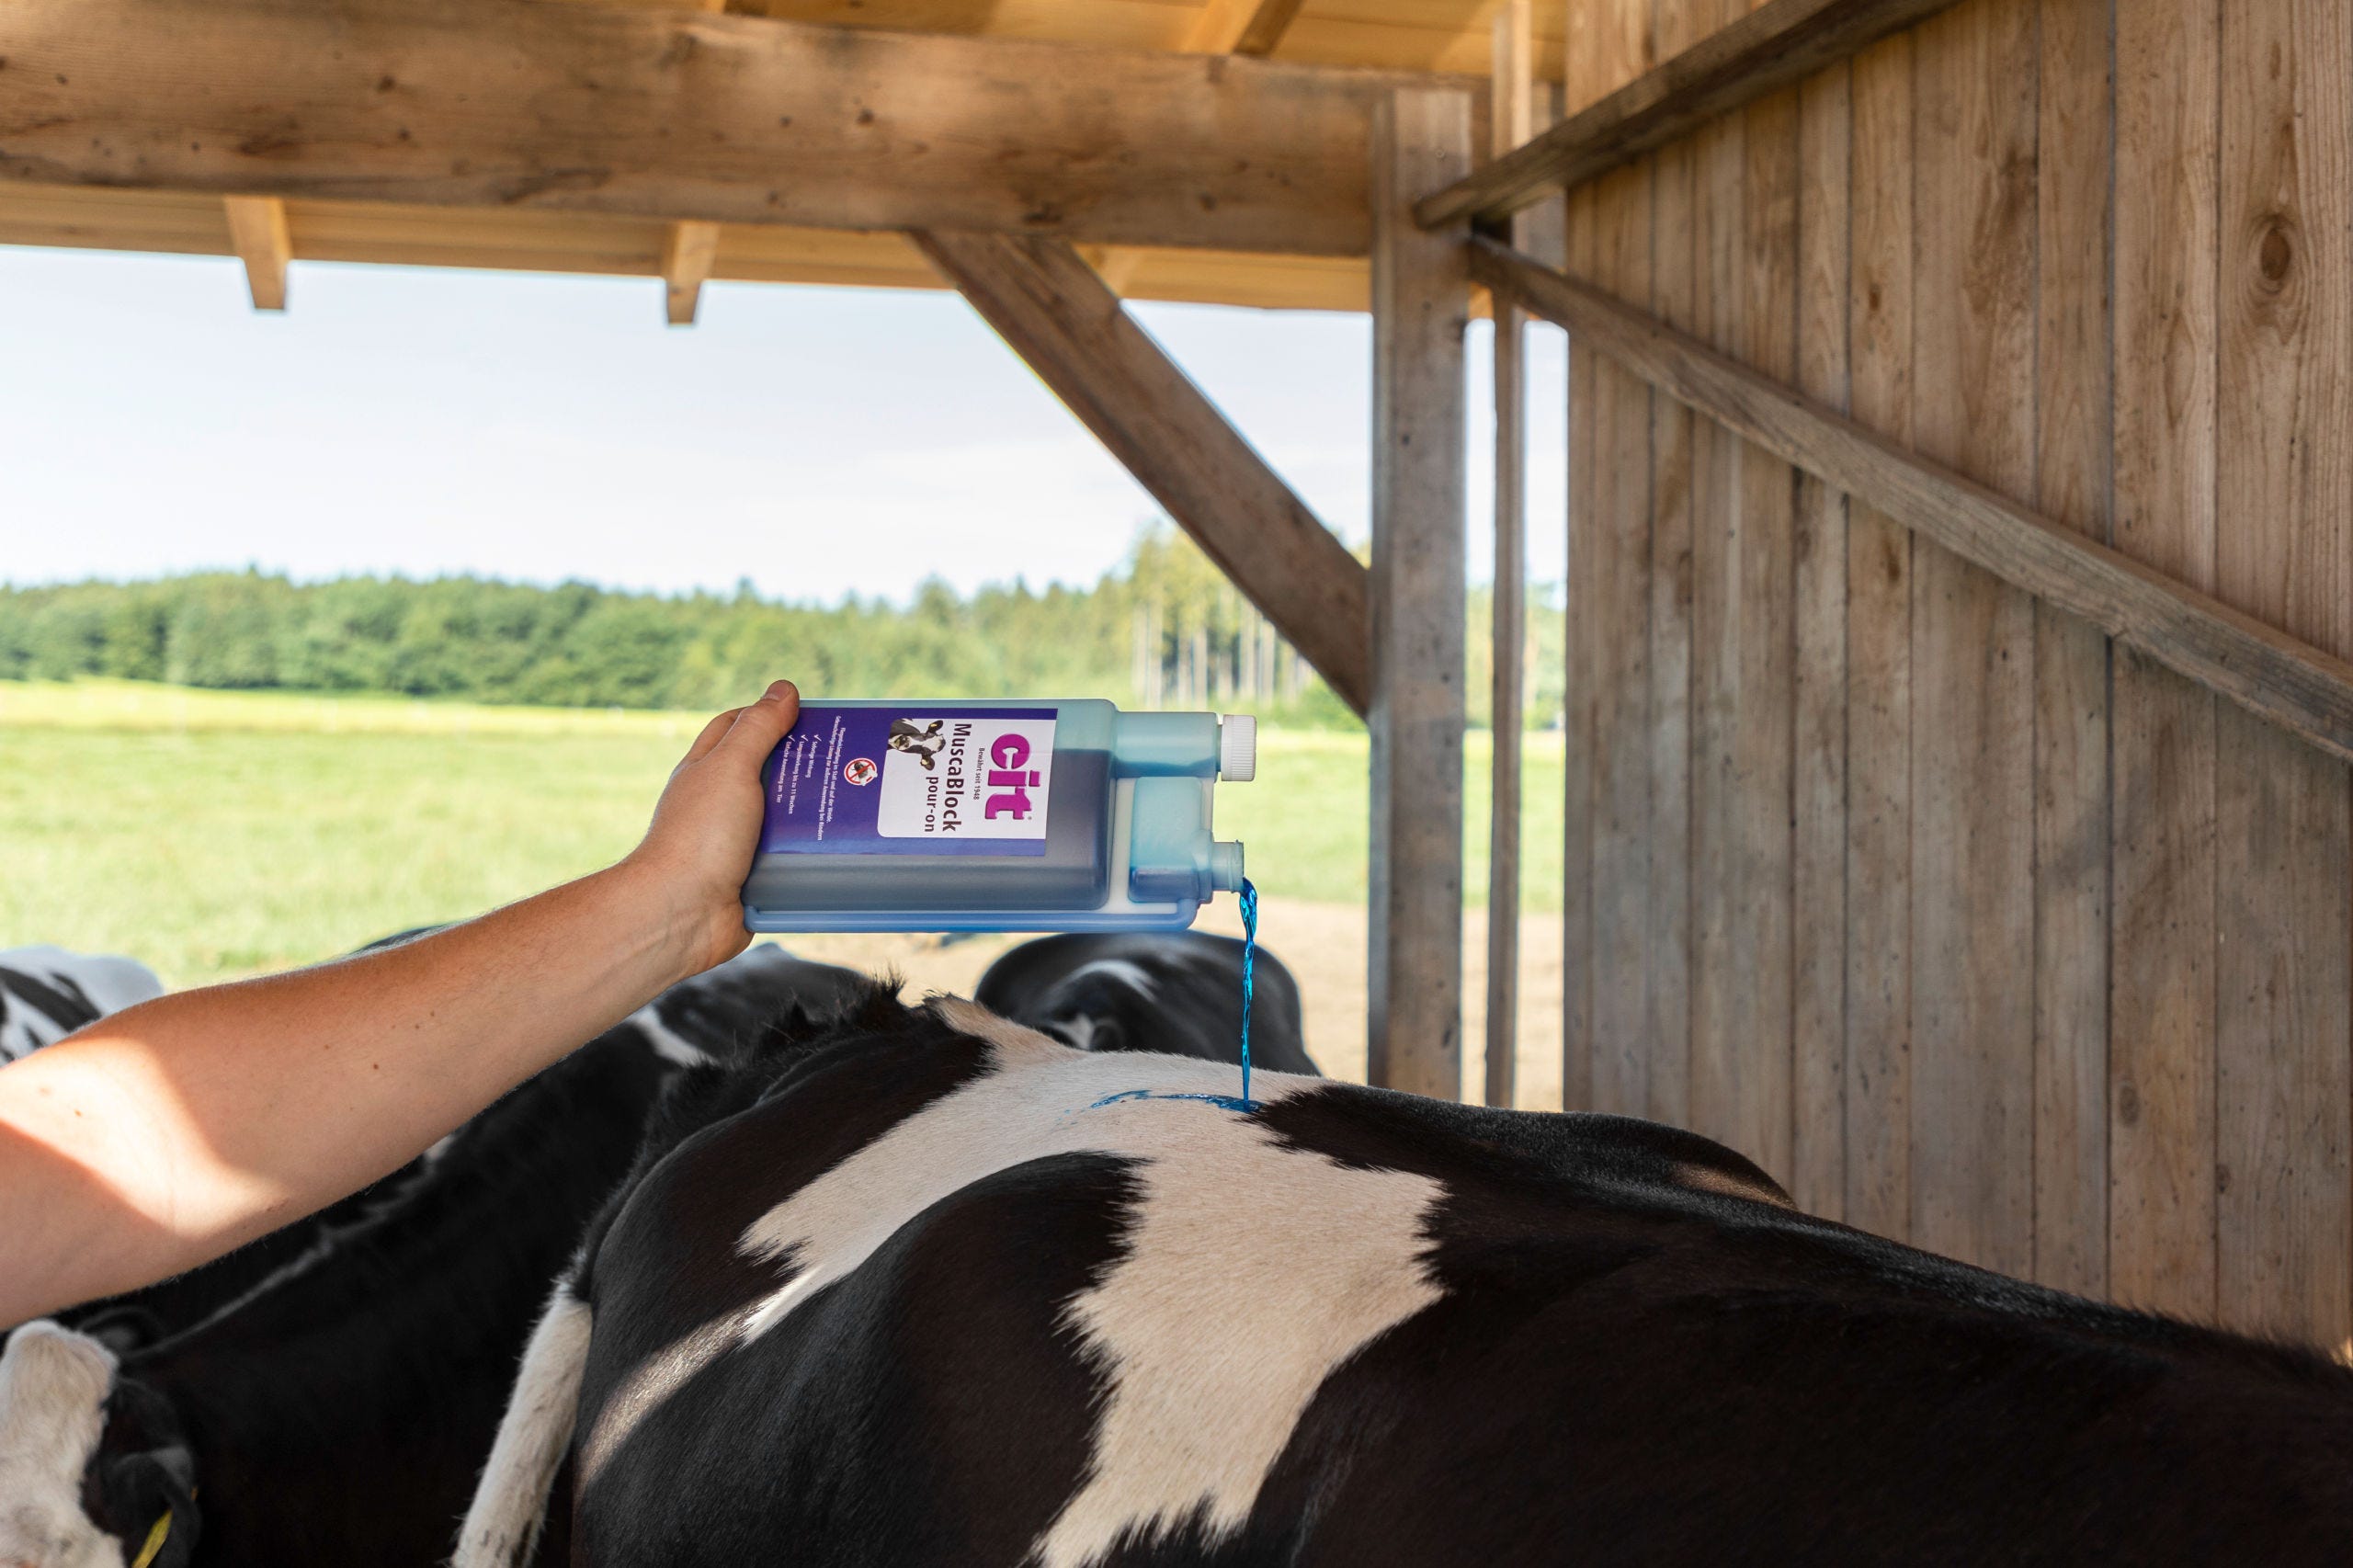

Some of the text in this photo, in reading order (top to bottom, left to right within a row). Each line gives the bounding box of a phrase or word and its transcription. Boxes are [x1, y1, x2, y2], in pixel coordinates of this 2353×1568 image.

[784, 741, 792, 758] Einfache
[792, 741, 805, 774] Langzeitwirkung
[805, 741, 818, 778] Sofortige Wirkung
[826, 744, 835, 759] Lösung
[976, 747, 985, 771] Bewährt
[777, 759, 788, 784] Anwendung
[942, 723, 972, 832] MuscaBlock
[984, 733, 1040, 820] cit
[818, 785, 828, 812] Anwendung
[924, 777, 939, 832] pour-on
